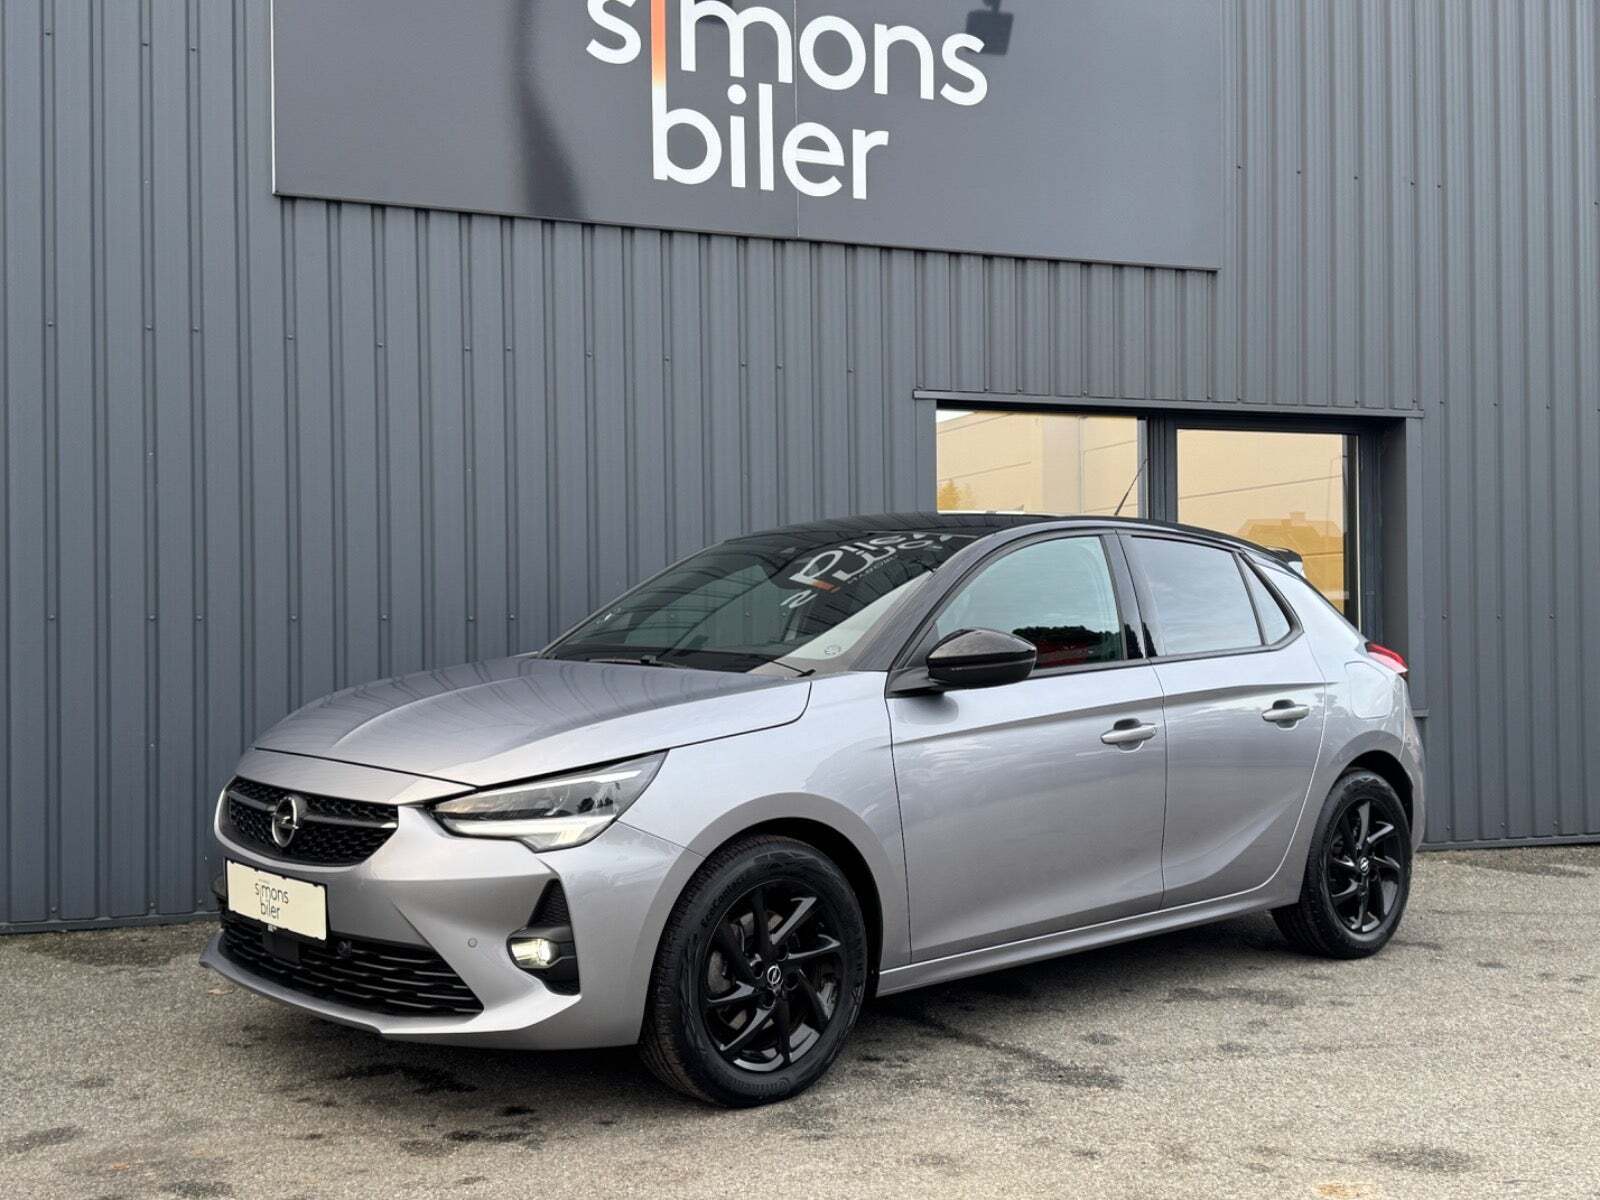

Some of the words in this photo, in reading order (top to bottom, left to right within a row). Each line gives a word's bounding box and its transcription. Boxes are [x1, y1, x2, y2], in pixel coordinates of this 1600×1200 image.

[651, 82, 889, 200] biler
[254, 882, 289, 904] simons
[259, 899, 281, 920] biler
